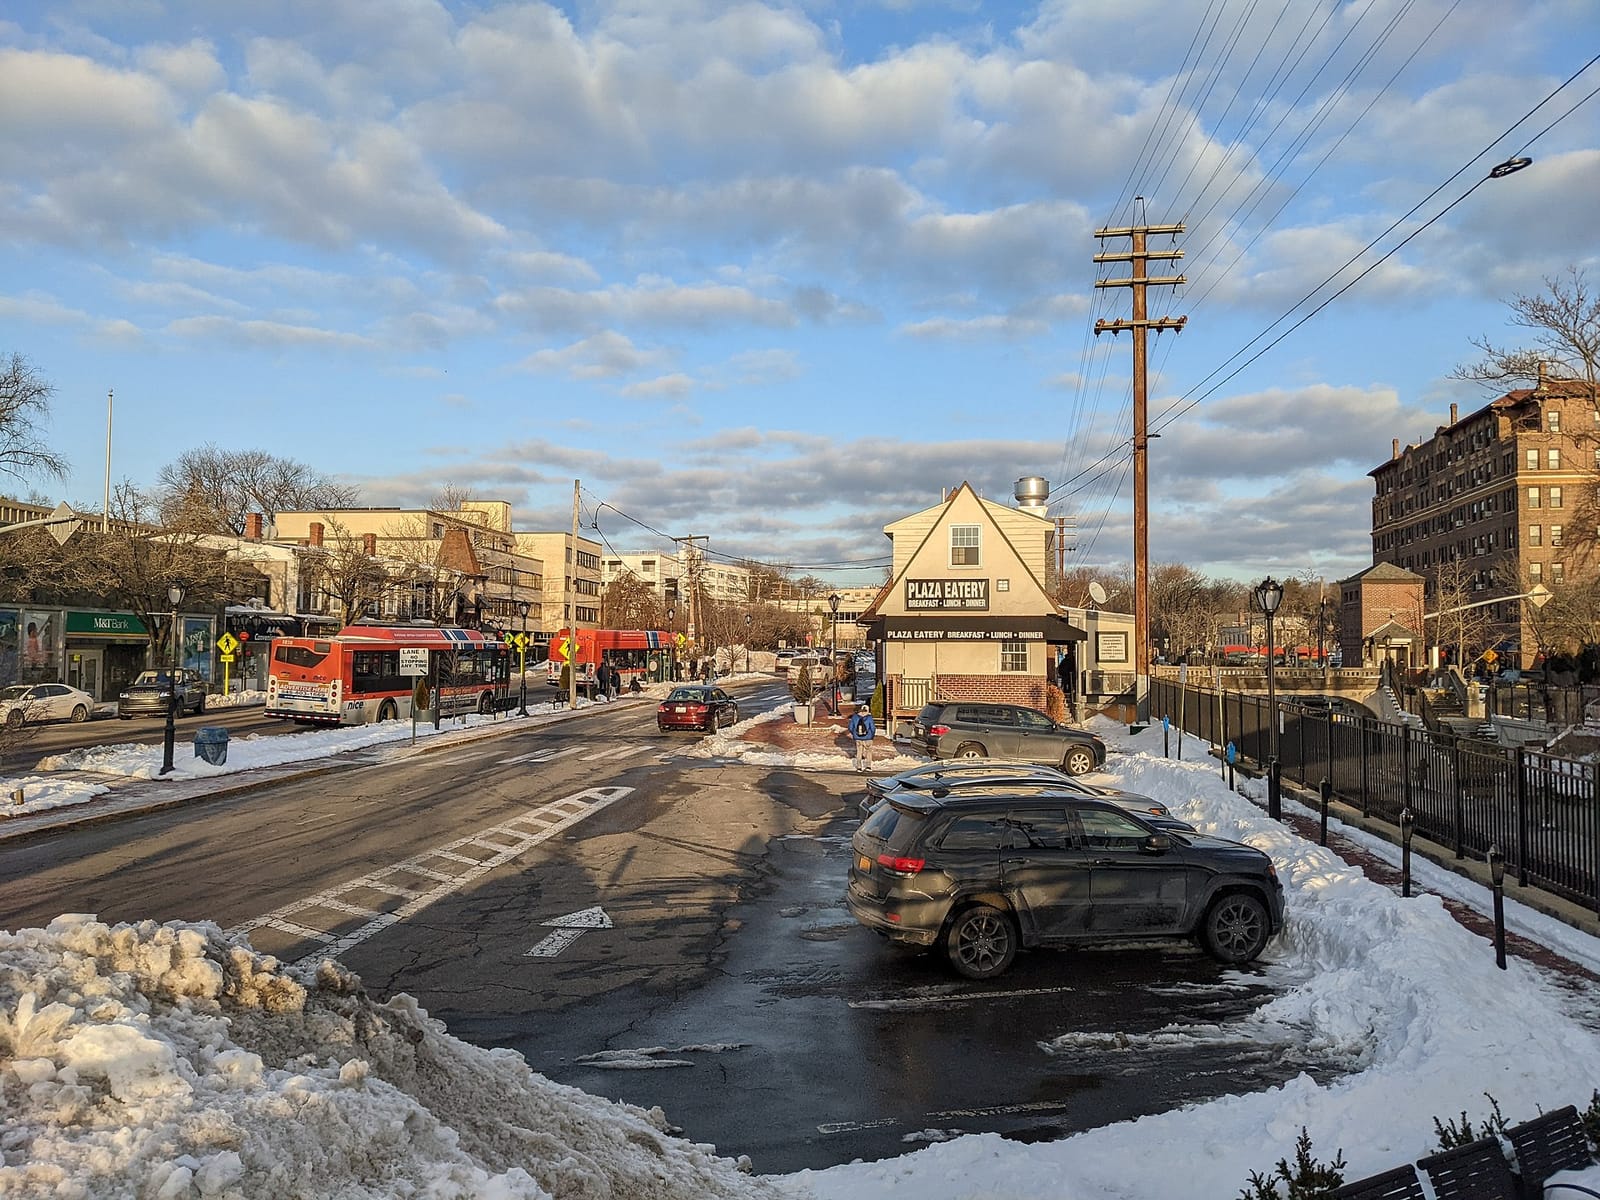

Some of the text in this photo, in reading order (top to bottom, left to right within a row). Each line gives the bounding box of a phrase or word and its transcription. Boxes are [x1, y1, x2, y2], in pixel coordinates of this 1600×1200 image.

[908, 581, 986, 599] PLAZA EATERY
[908, 599, 986, 608] BREAKFAST LUNCH DINNER
[111, 619, 129, 629] Bank
[887, 631, 1044, 639] PLAZA EATERY BREAKFAST LUNCH DINNER
[347, 700, 365, 710] nice
